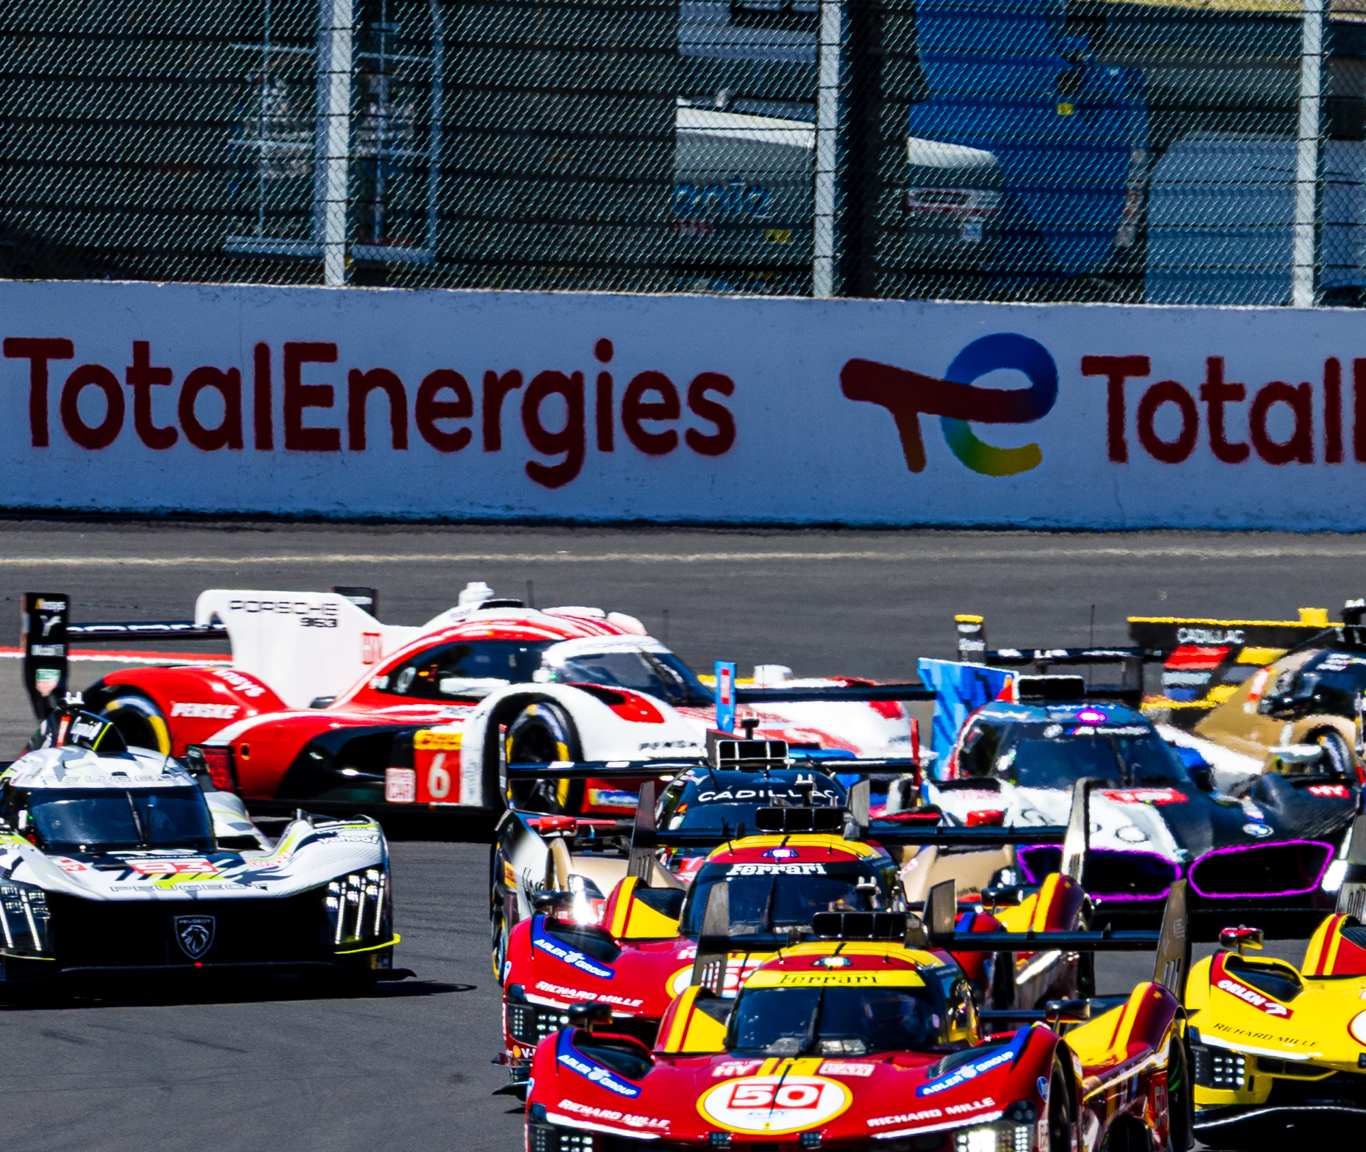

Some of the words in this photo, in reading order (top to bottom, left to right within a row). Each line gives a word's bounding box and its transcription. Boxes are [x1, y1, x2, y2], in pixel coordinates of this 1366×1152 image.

[3, 337, 735, 488] TotalEnergies
[229, 601, 338, 616] PORSCHE
[301, 617, 337, 627] 963
[171, 702, 240, 720] PENSKE
[427, 753, 451, 788] 6
[318, 834, 379, 844] yahoo!
[134, 861, 211, 873] 93
[726, 862, 827, 876] Ferrari
[108, 882, 270, 893] PEUGEOT
[178, 917, 212, 925] PEUGEOT
[533, 938, 568, 959] ADLER
[573, 959, 613, 978] GROUP
[779, 973, 879, 986] Ferrari
[535, 980, 598, 1001] RICHARD
[597, 994, 644, 1008] MILLE
[1217, 978, 1267, 1007] ORLEN
[1212, 1022, 1274, 1041] RICHARD
[1276, 1035, 1320, 1048] MILLE
[557, 1054, 591, 1074] ADLER
[599, 1077, 637, 1096] GROUP
[711, 1065, 755, 1077] HY
[922, 1075, 964, 1095] ADLER
[975, 1051, 1014, 1073] GROUP
[731, 1085, 820, 1107] 50
[557, 1099, 622, 1121] RICHARD
[621, 1113, 671, 1128] MILLE
[867, 1108, 943, 1127] RICHARD
[945, 1097, 996, 1115] MILLE
